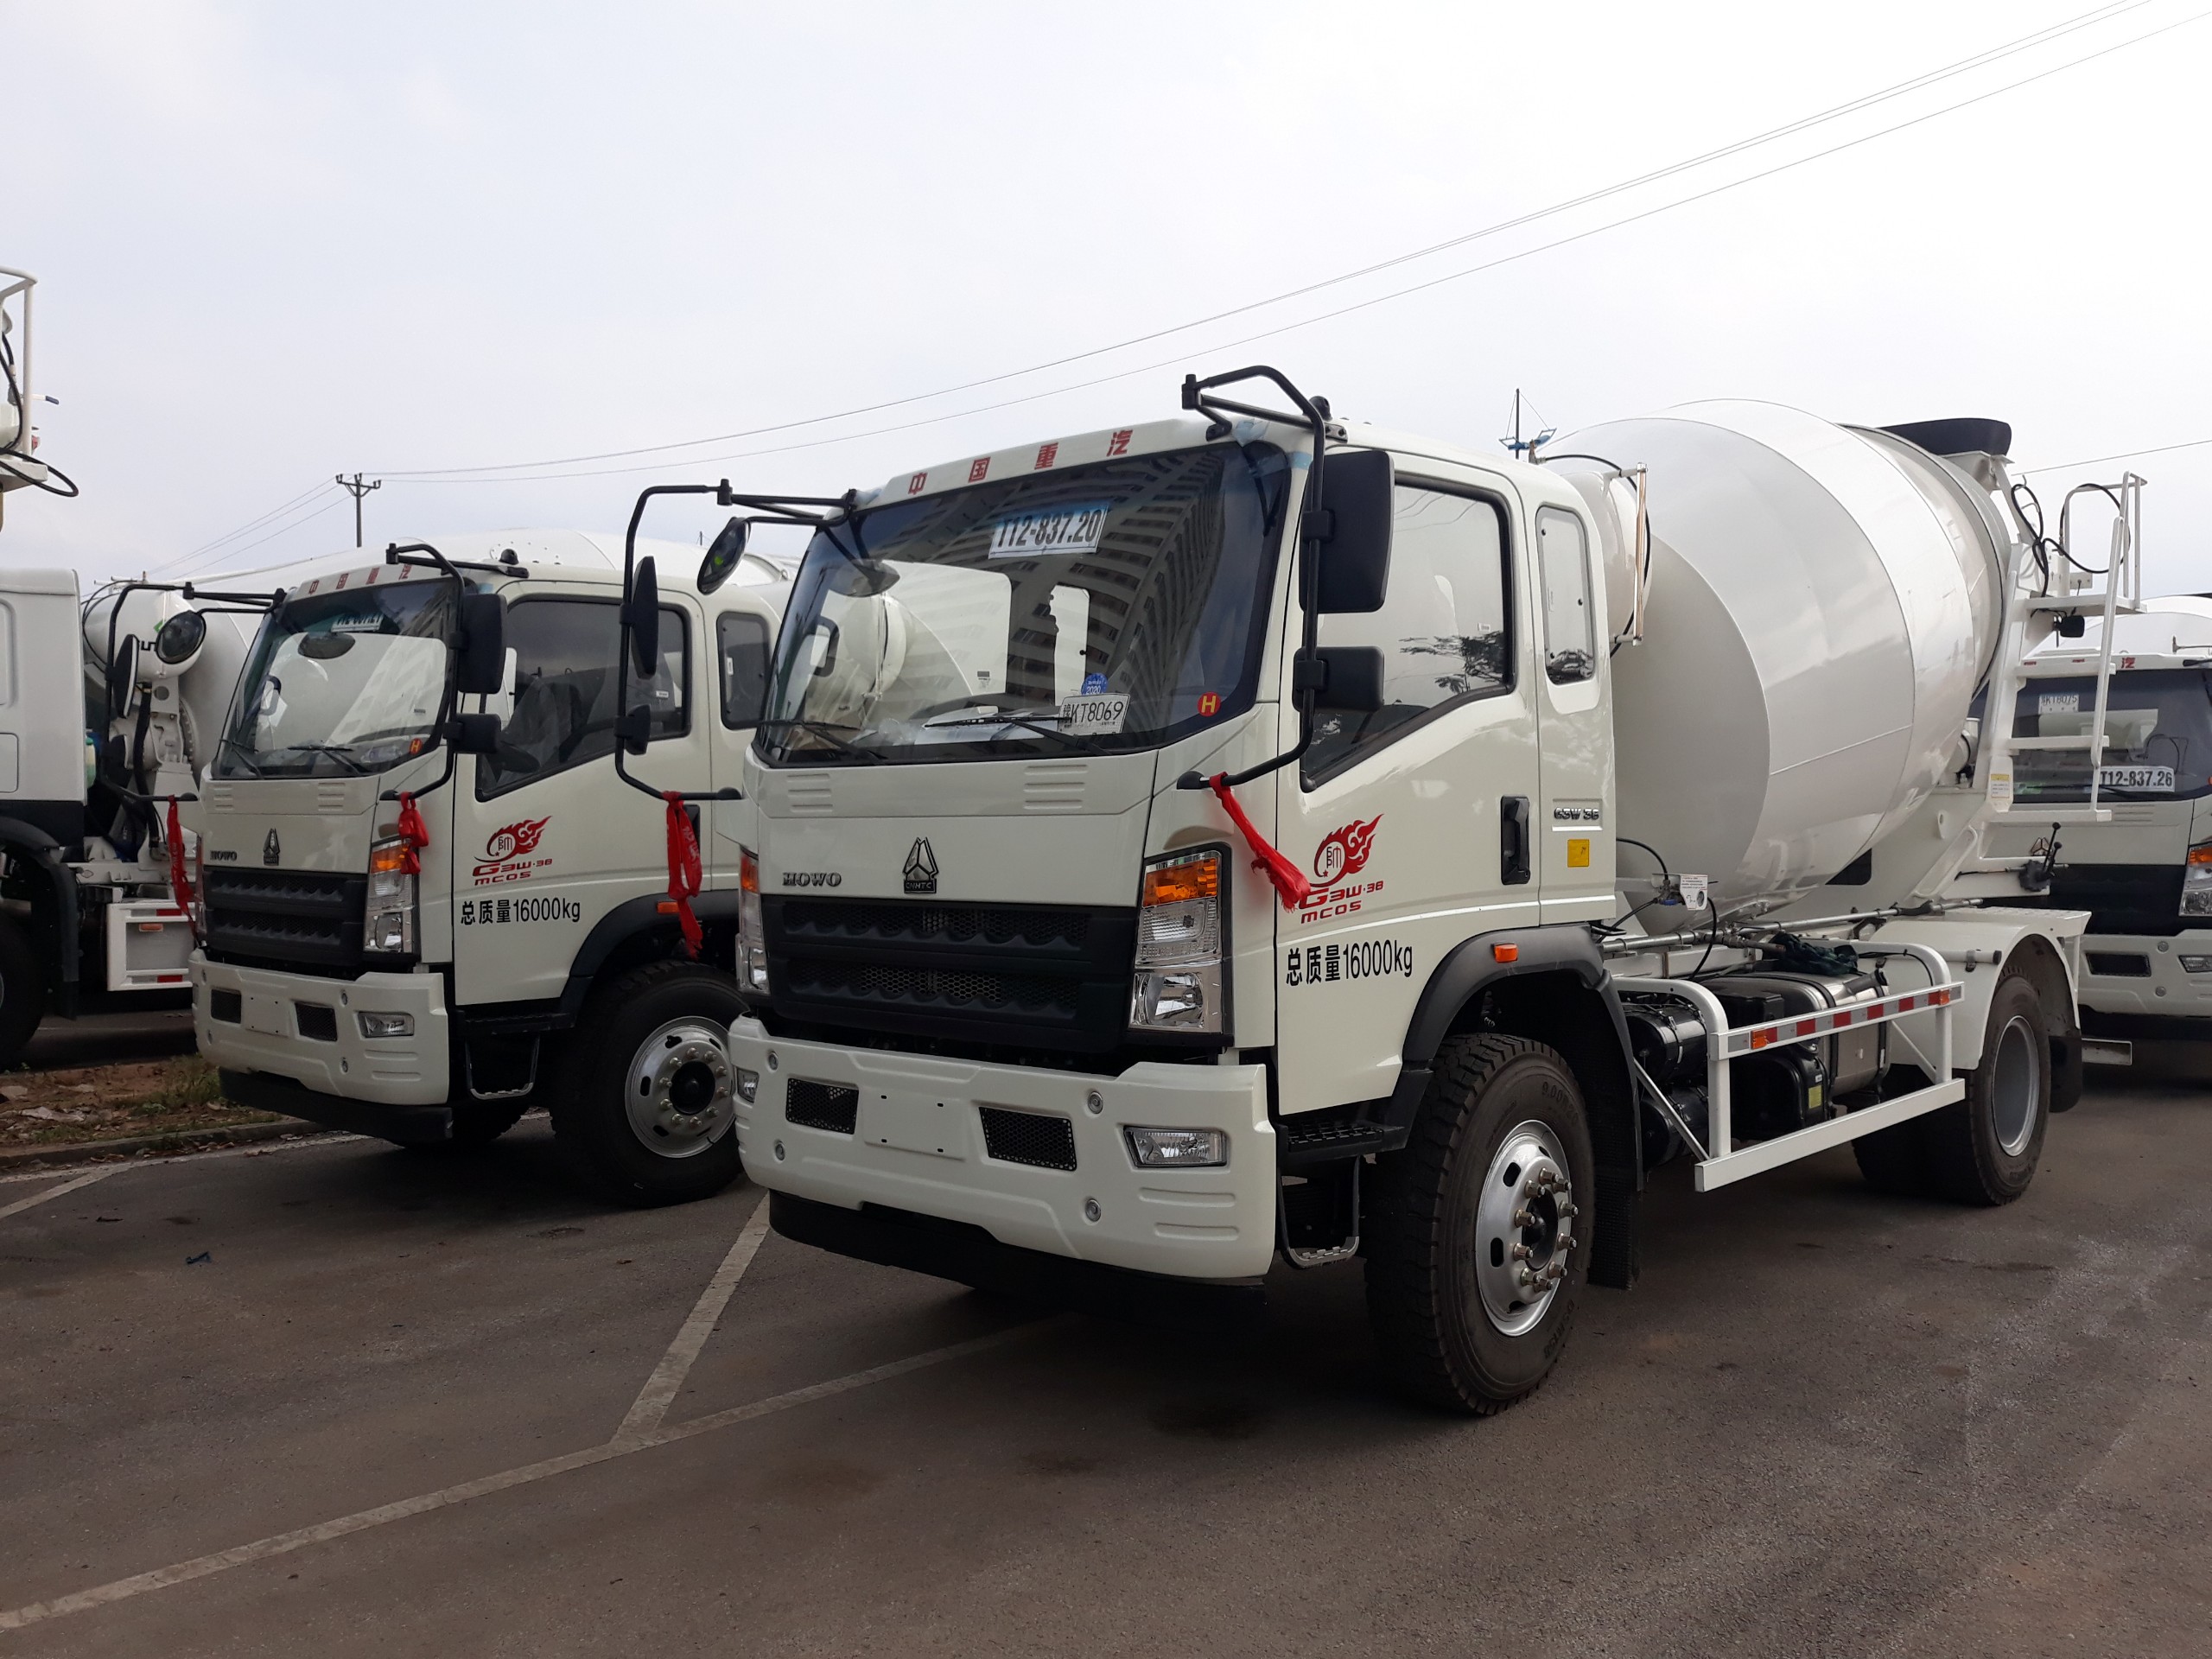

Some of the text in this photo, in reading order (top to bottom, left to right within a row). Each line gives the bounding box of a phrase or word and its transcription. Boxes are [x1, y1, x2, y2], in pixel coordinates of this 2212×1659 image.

[908, 429, 1133, 495] 中国重汽
[997, 509, 1103, 548] T12-837.20
[1201, 695, 1217, 714] H
[410, 741, 419, 753] H
[2101, 771, 2172, 786] T12-837.26
[782, 872, 842, 887] HOWO
[461, 898, 581, 925] 总质量16000kg
[1286, 939, 1413, 987] 总质量16000kg
